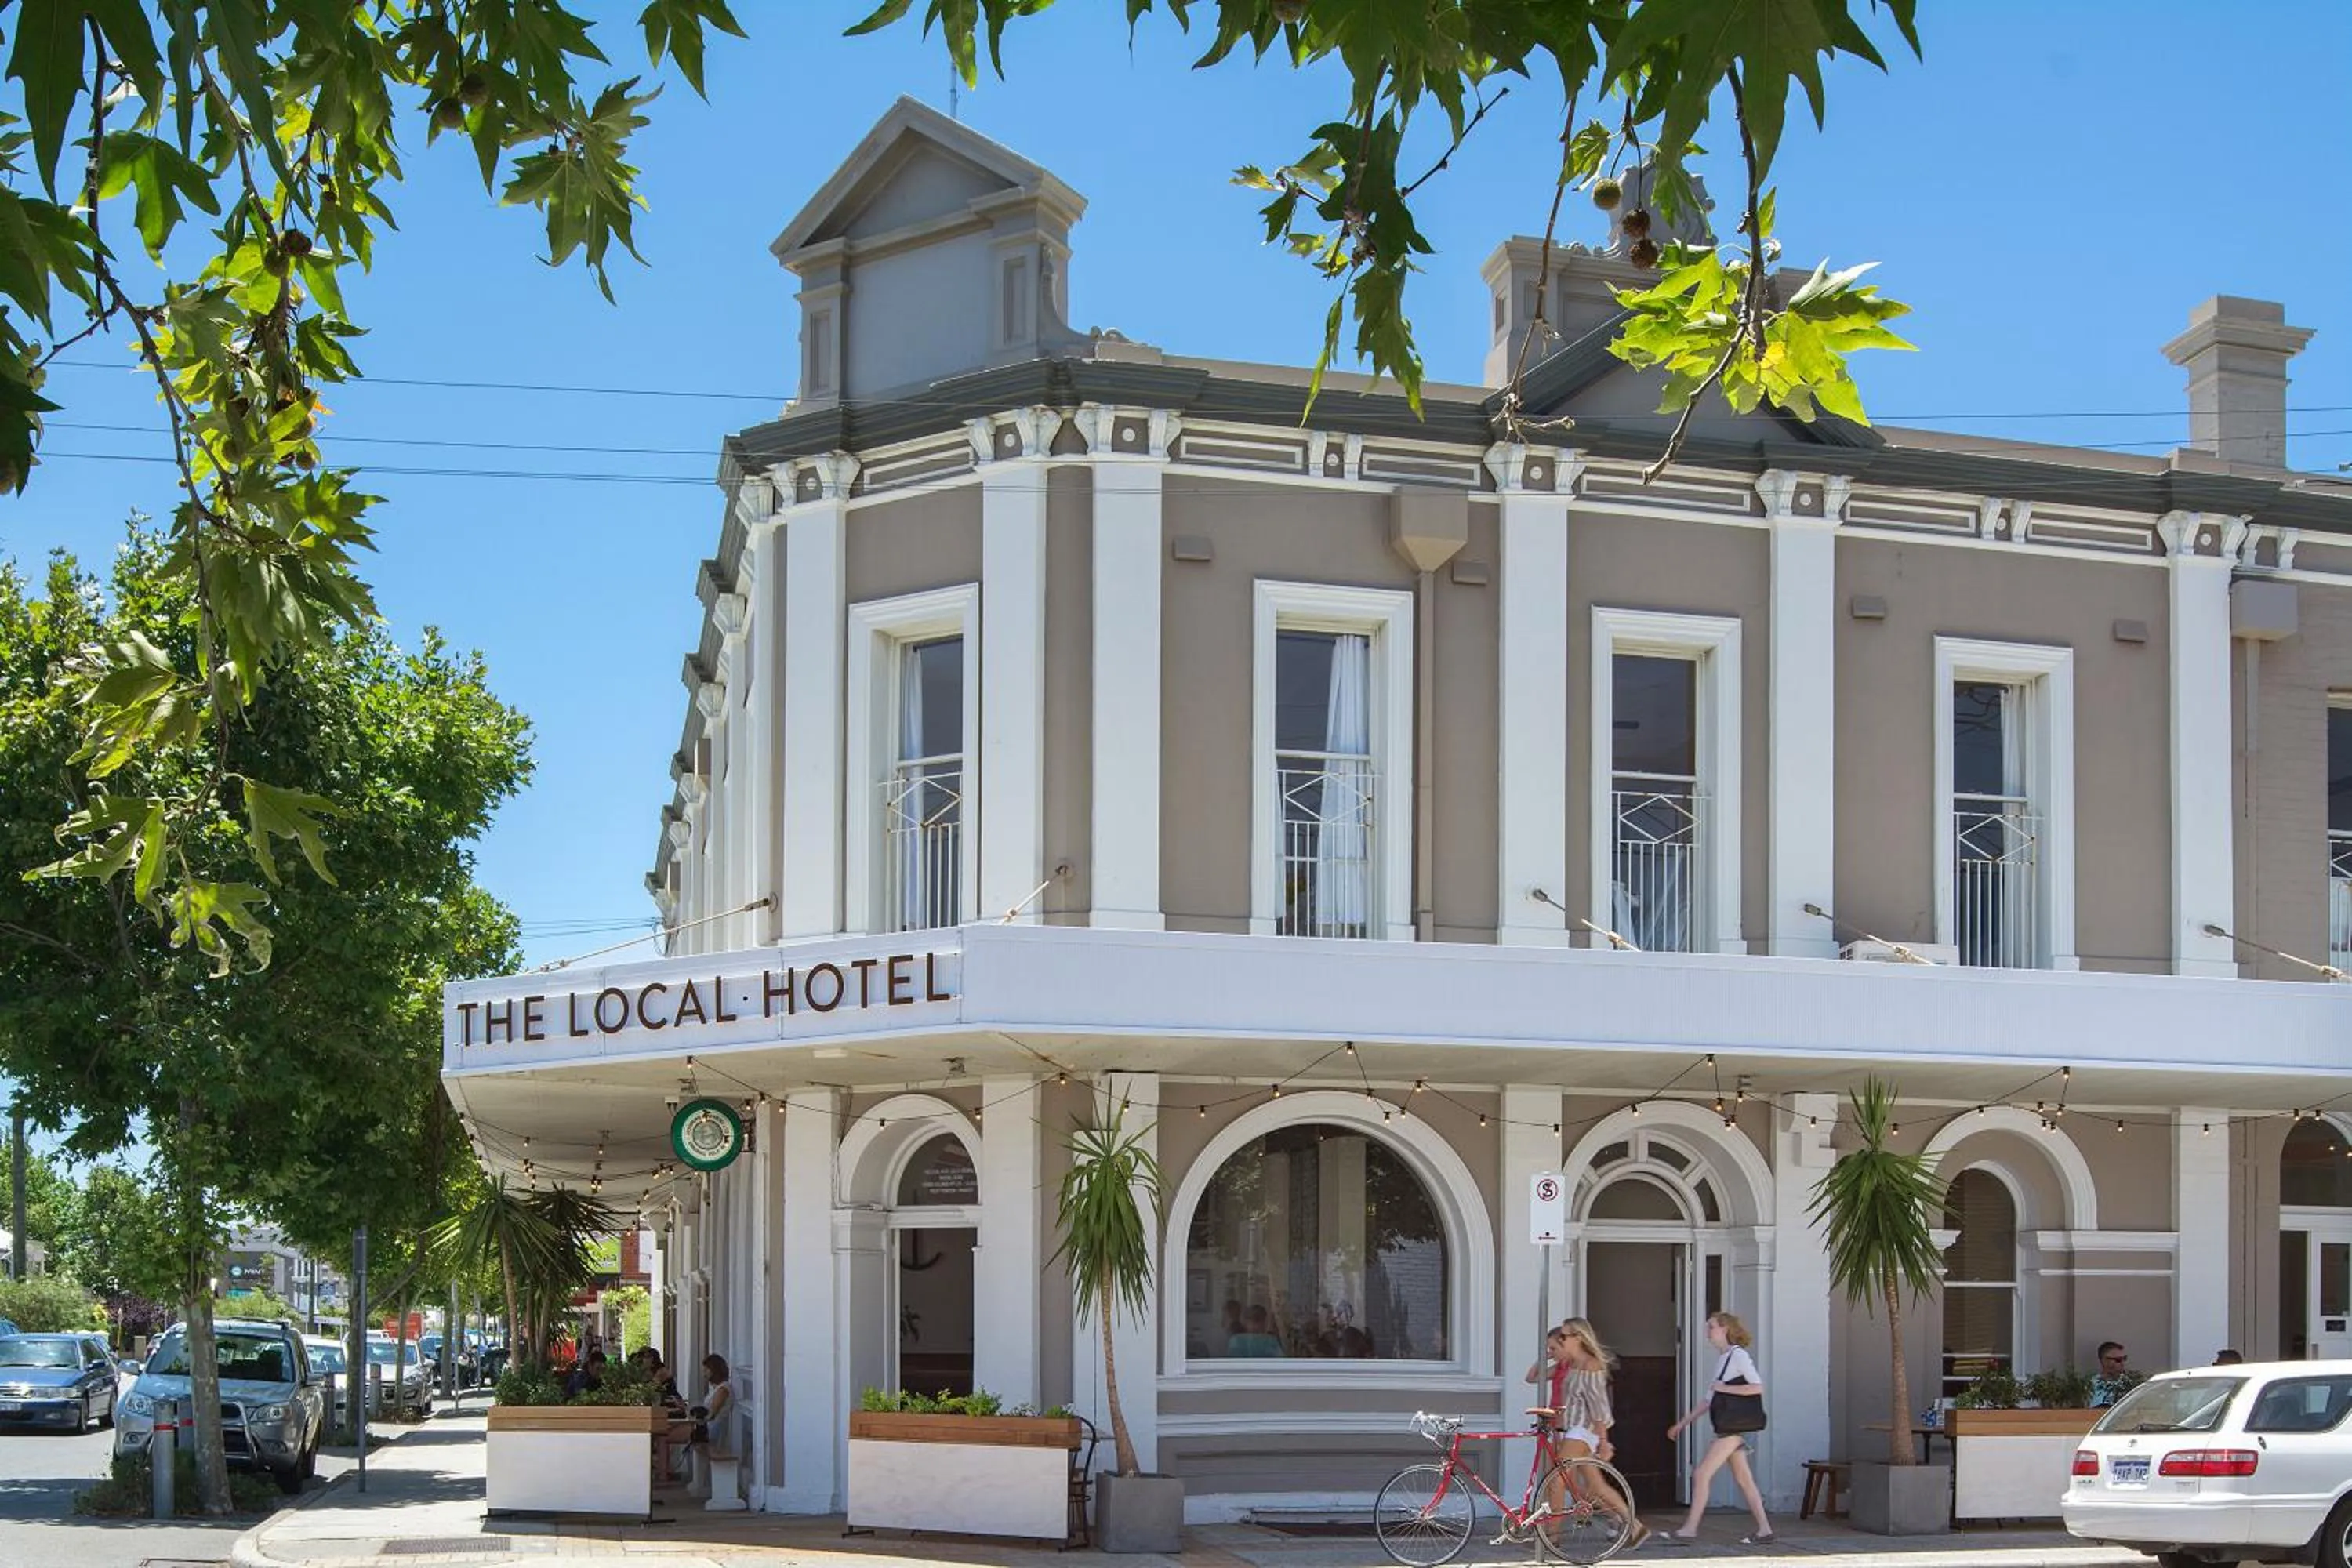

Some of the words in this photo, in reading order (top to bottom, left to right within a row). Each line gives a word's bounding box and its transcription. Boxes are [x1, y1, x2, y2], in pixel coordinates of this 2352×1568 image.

[456, 995, 545, 1047] THE
[569, 976, 738, 1037] LOCAL
[763, 953, 951, 1018] HOTEL
